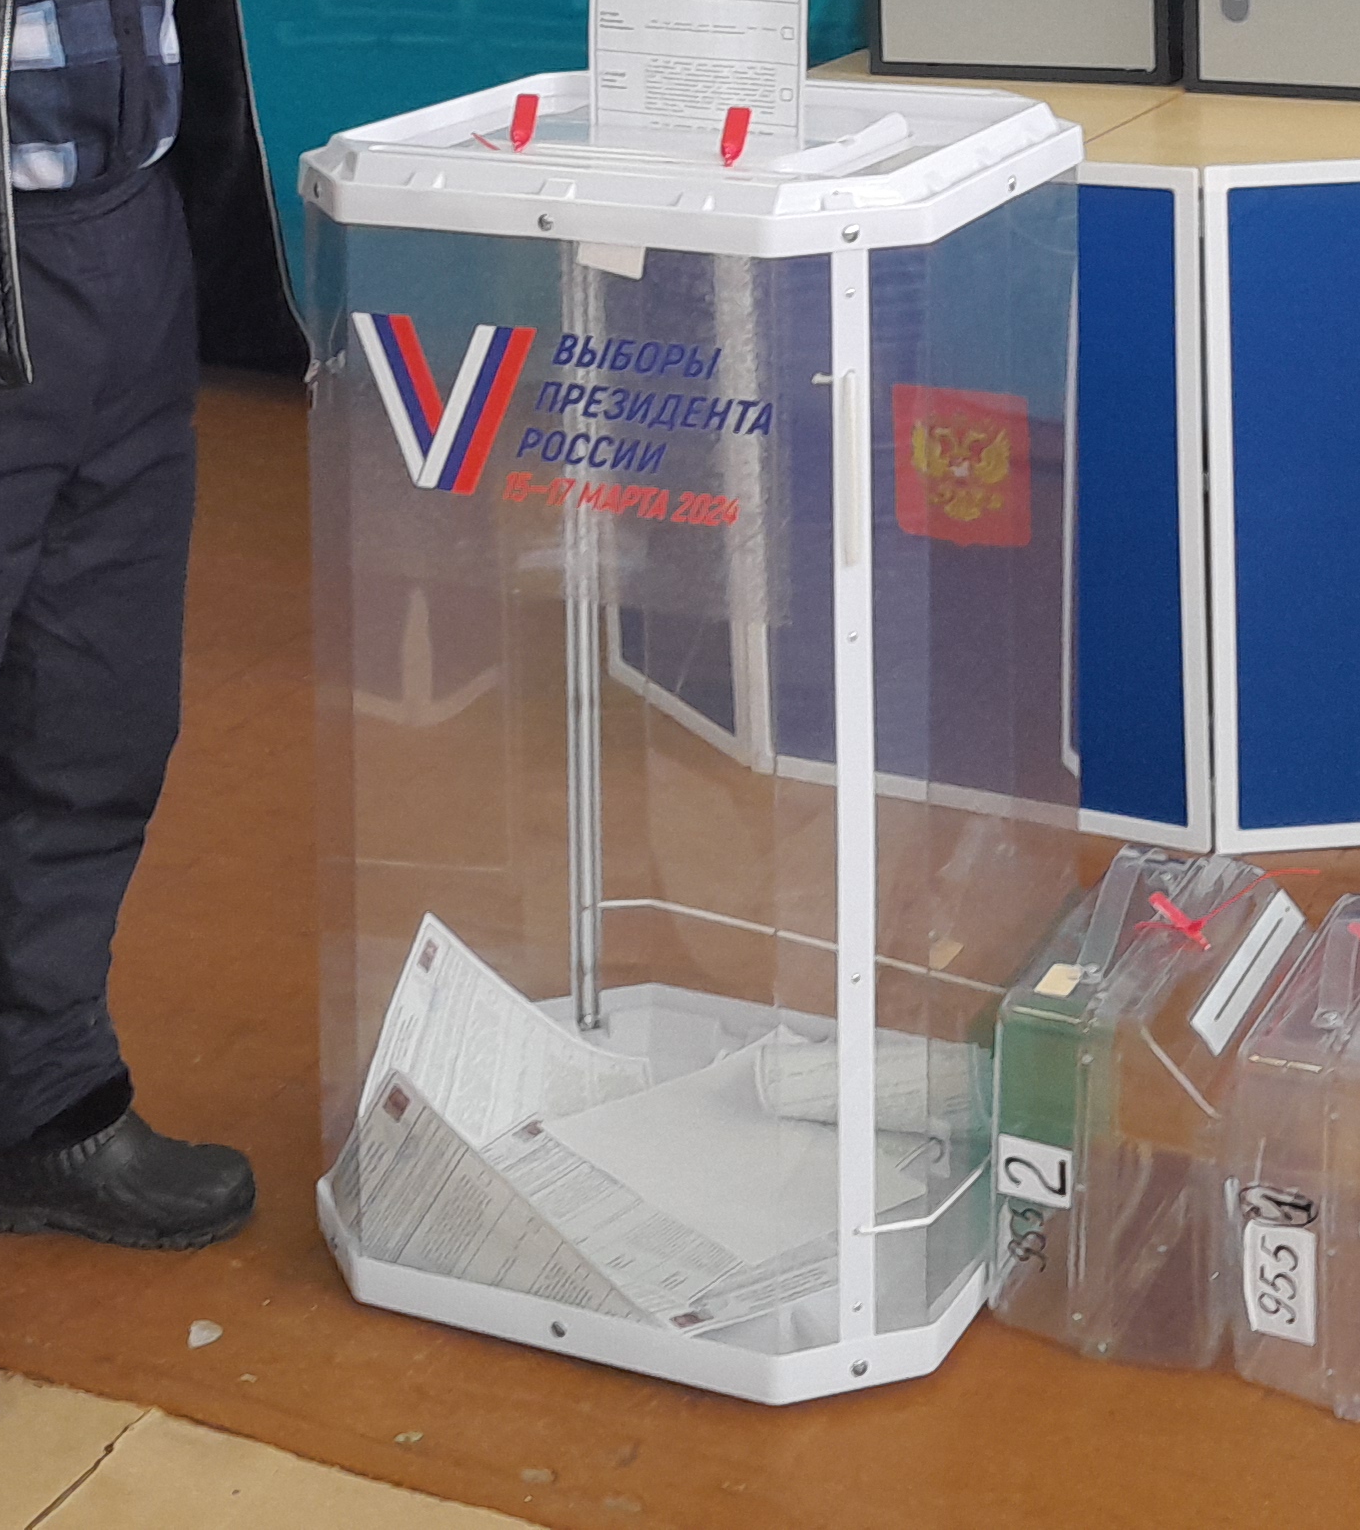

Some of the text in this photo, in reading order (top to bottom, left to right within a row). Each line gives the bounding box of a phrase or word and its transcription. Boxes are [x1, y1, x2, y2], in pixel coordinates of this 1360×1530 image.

[552, 333, 722, 380] ВЫБОРЫ
[534, 381, 774, 436] ПРЕЗИДЕНТА
[516, 427, 667, 473] РОССИИ
[577, 482, 670, 520] МАРТА
[670, 490, 739, 527] 2024
[1004, 1156, 1068, 1196] 2
[1257, 1234, 1299, 1325] 955
